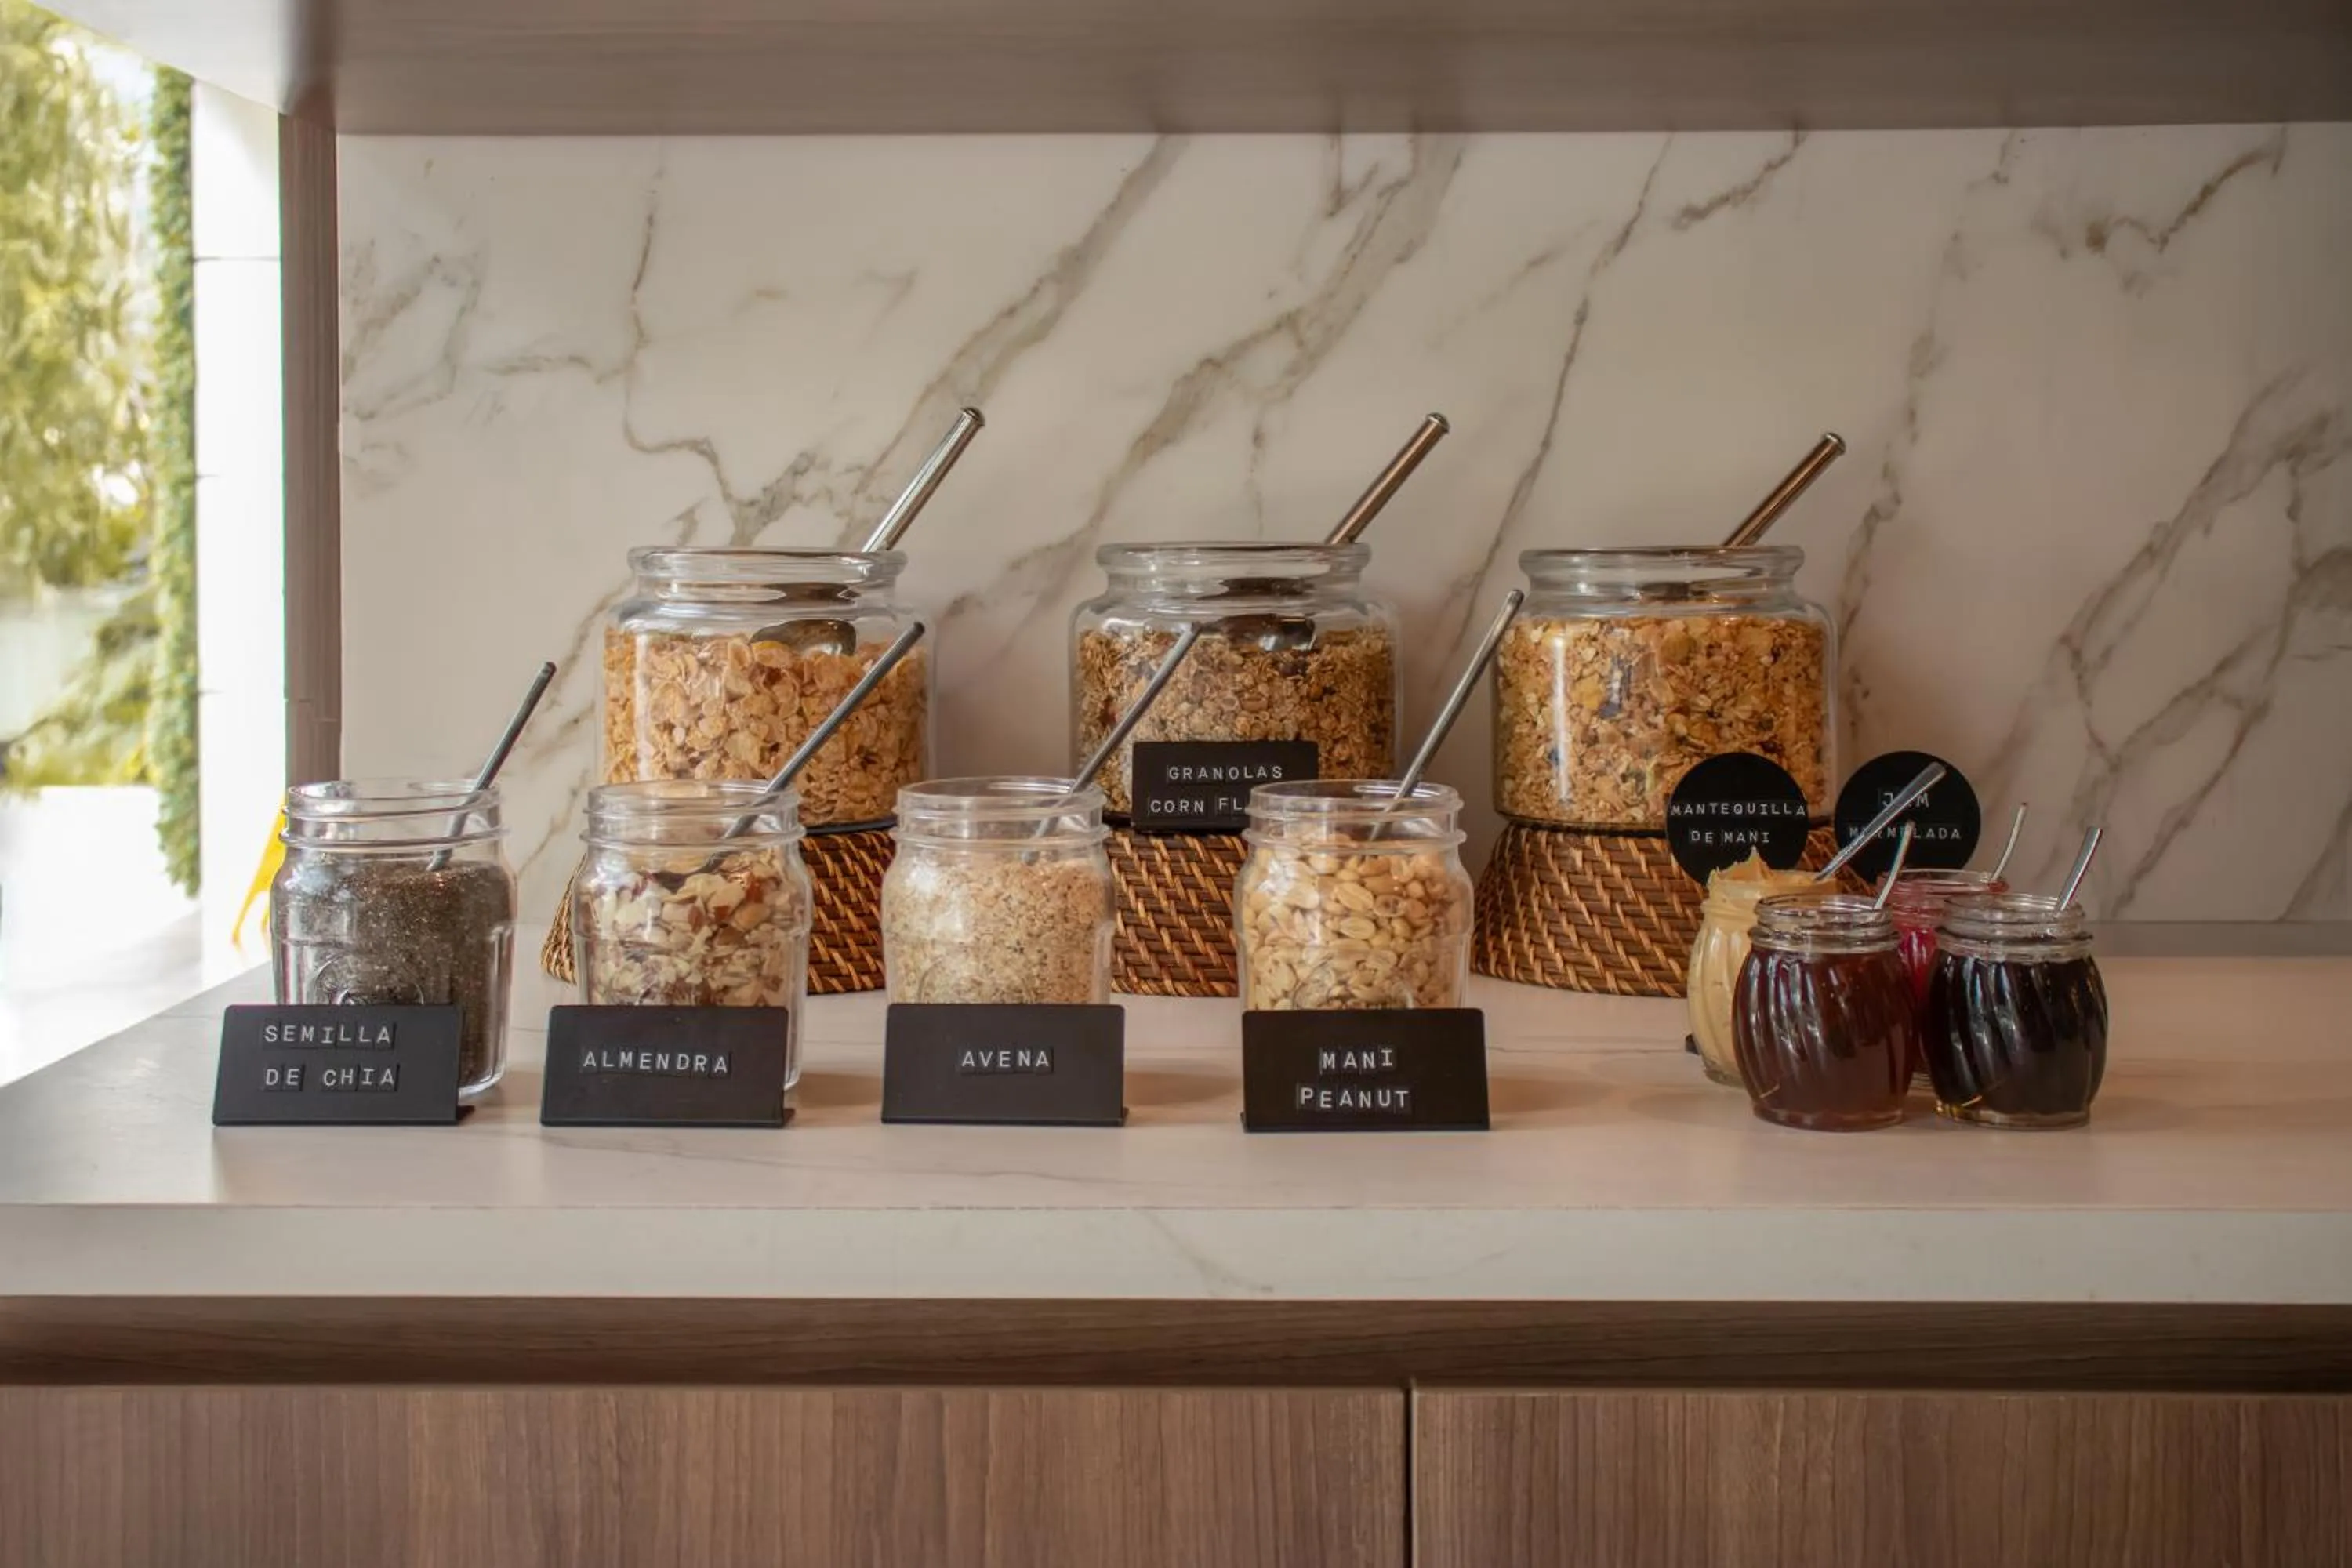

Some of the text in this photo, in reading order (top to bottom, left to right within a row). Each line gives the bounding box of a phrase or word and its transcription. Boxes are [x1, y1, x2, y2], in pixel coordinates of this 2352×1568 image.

[1168, 765, 1283, 781] GRANOLAS
[1150, 797, 1243, 814] CORN FL
[1882, 792, 1930, 808] JM
[1670, 802, 1806, 817] MANTEQUILLA
[1690, 829, 1770, 844] DE MANI
[263, 1024, 390, 1044] SEMILLA
[583, 1051, 728, 1073] ALMENDRA
[962, 1051, 1049, 1067] AVENA
[1323, 1049, 1393, 1069] MANI
[265, 1068, 394, 1087] DE CHIA
[1300, 1087, 1409, 1109] PEANUT
